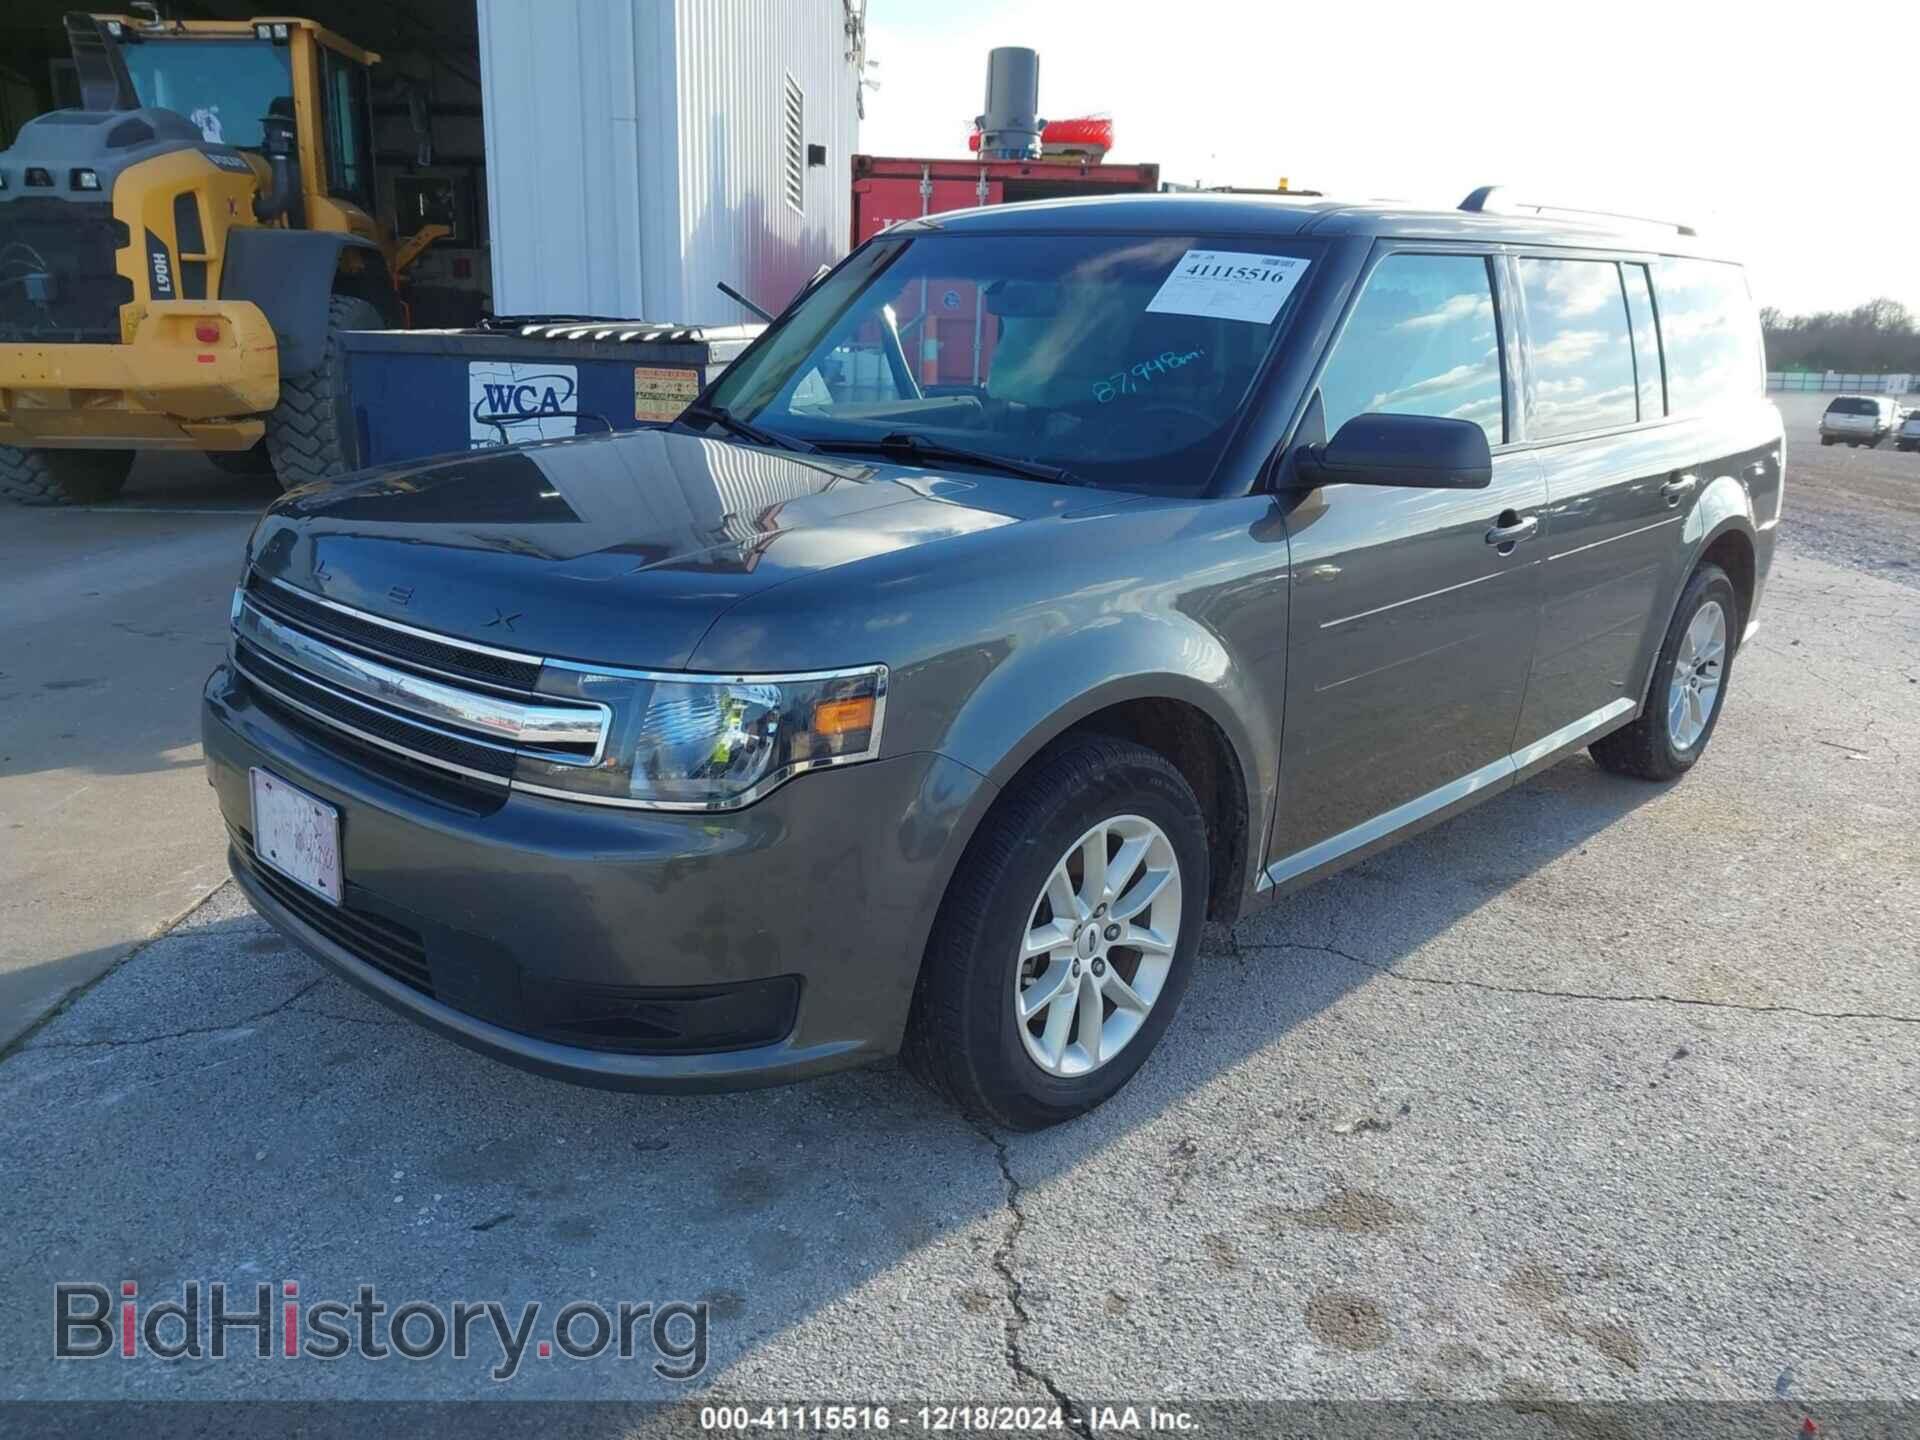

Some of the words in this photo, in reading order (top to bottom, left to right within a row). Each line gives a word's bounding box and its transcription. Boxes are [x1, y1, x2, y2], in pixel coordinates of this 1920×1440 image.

[153, 253, 170, 291] L90H
[1186, 263, 1284, 283] 41115516
[483, 384, 561, 415] WCA
